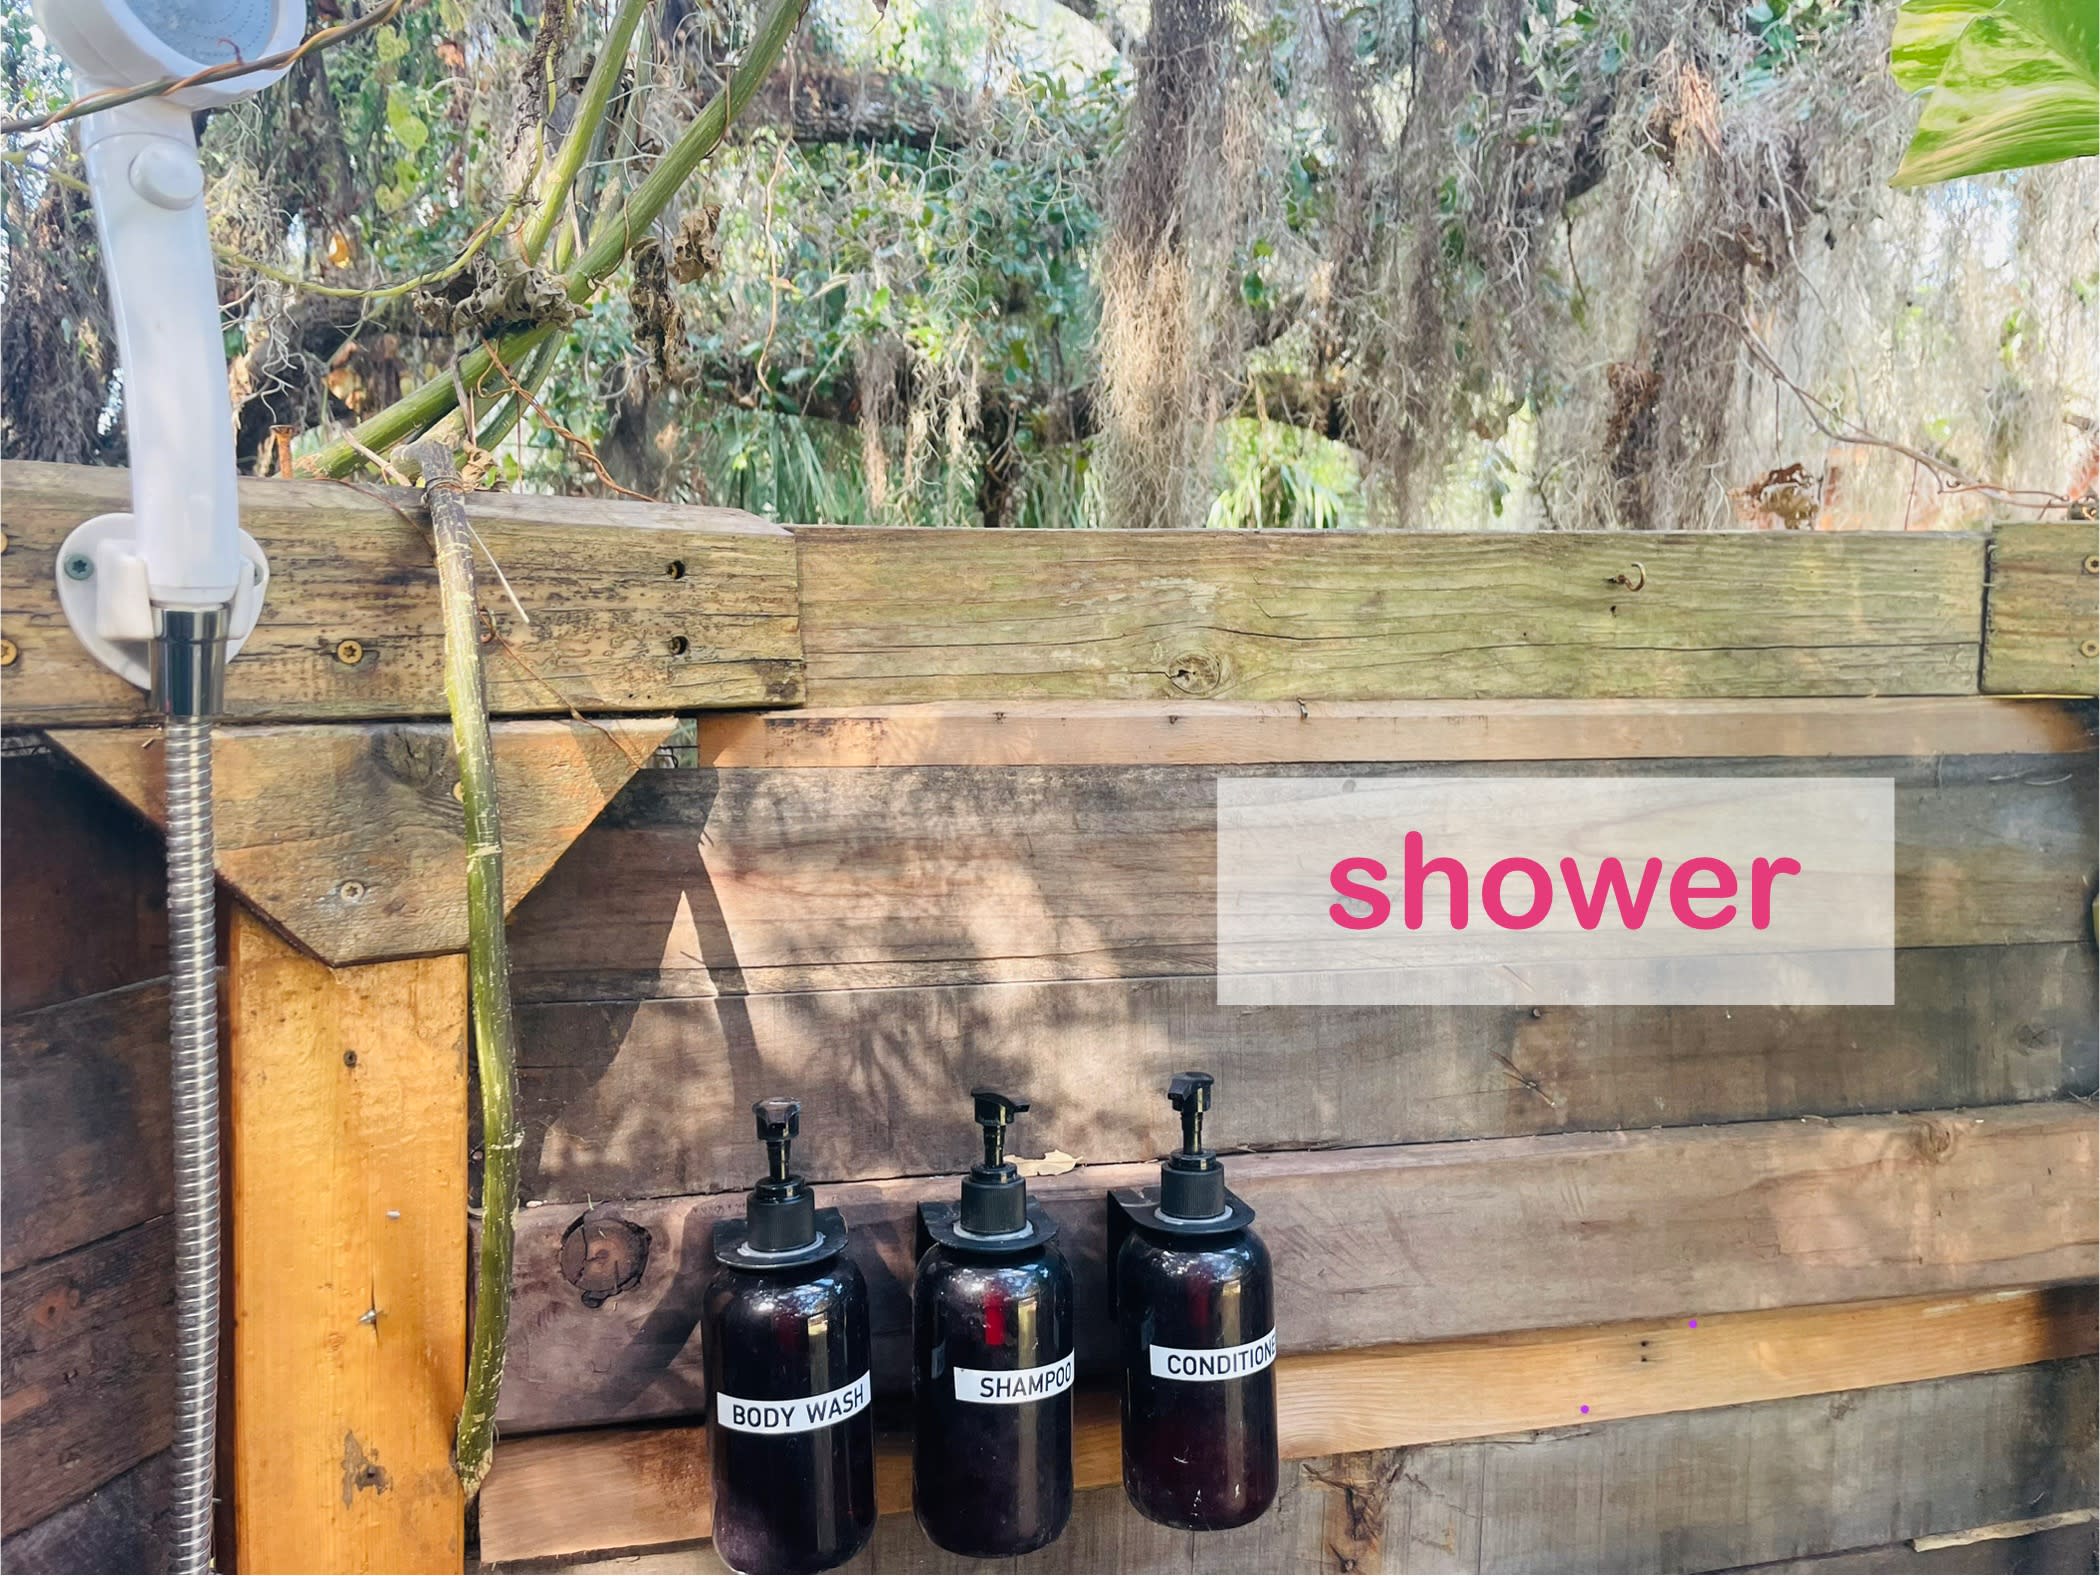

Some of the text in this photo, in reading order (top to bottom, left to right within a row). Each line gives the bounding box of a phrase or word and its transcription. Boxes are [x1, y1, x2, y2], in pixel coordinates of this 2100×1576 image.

[979, 1362, 1072, 1398] SHAMPOO
[732, 1383, 864, 1428] BODY WASH
